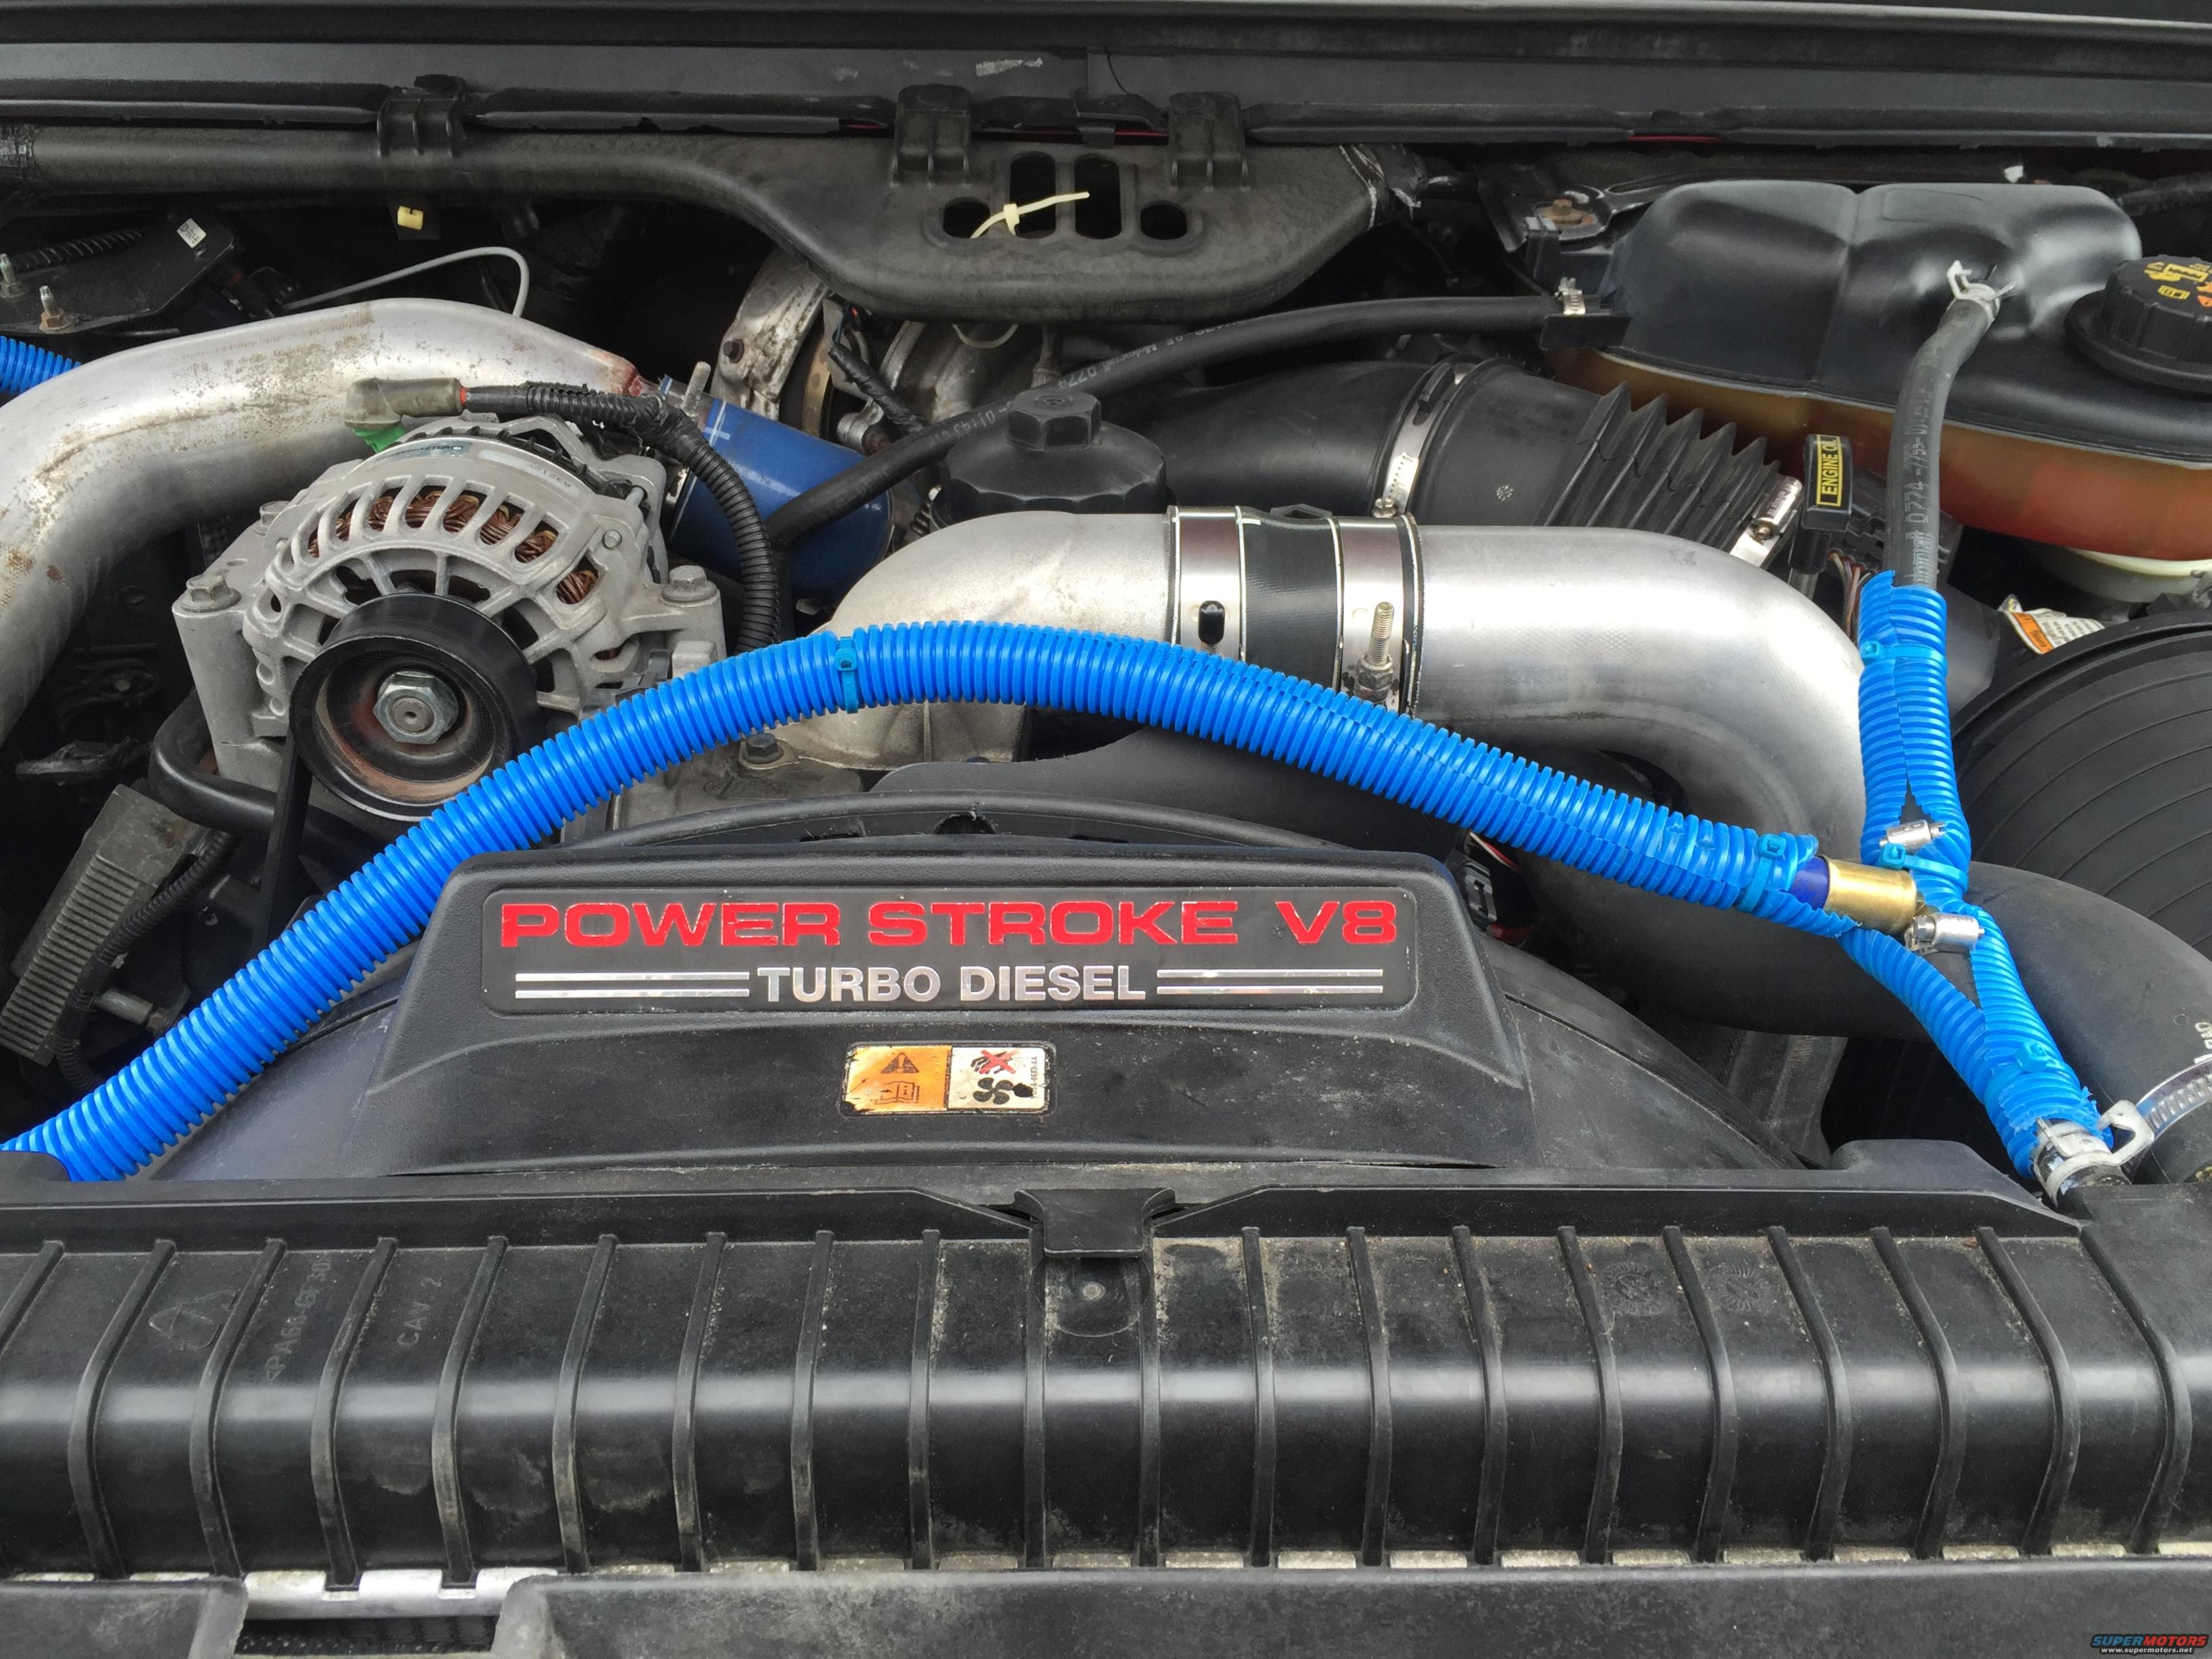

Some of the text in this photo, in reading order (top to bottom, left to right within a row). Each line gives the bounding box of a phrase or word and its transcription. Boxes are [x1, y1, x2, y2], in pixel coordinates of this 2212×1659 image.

[1821, 453, 1839, 496] ENGINE
[501, 901, 1397, 947] POWER STROKE V8
[757, 964, 1146, 1002] TURBO DIESEL
